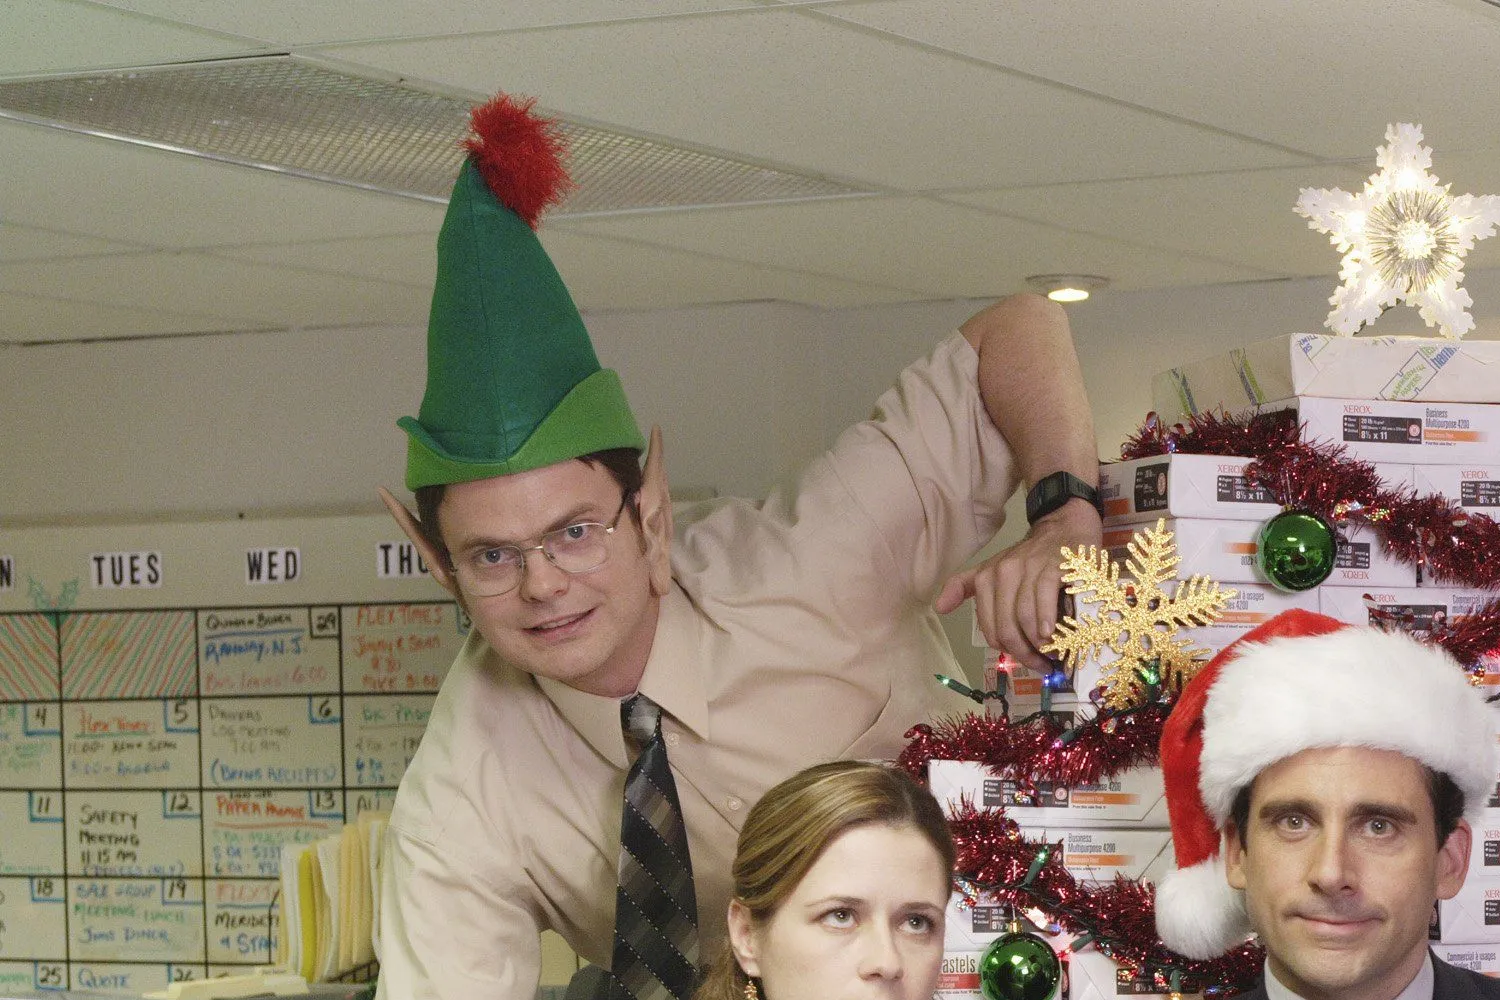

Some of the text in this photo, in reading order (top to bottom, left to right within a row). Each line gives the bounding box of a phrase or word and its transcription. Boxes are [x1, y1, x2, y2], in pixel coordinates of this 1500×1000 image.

[1343, 405, 1372, 414] XEROX
[1426, 408, 1448, 418] Business
[1426, 418, 1470, 429] Multipurpose 4200
[1381, 432, 1388, 440] 11
[1217, 464, 1245, 473] XEROX
[1461, 471, 1488, 479] XEROX
[1256, 491, 1264, 500] 11
[247, 550, 298, 581] WED
[379, 544, 429, 574] THU
[93, 554, 160, 586] TUES
[1341, 570, 1369, 579] XEROX
[1236, 601, 1248, 610] 4200
[1372, 594, 1396, 602] EROX
[316, 612, 336, 632] 29
[36, 706, 47, 727] 4
[174, 701, 189, 724] 5
[320, 699, 332, 718] 6
[1109, 782, 1121, 791] 4200
[38, 796, 50, 814] 11
[169, 793, 193, 812] 12
[316, 790, 336, 811] 13
[1068, 834, 1091, 842] Business
[1068, 843, 1115, 853] Multipurpose 4200
[37, 879, 53, 896] 18
[169, 880, 187, 899] 19
[943, 955, 975, 974] astels
[40, 966, 61, 984] 25
